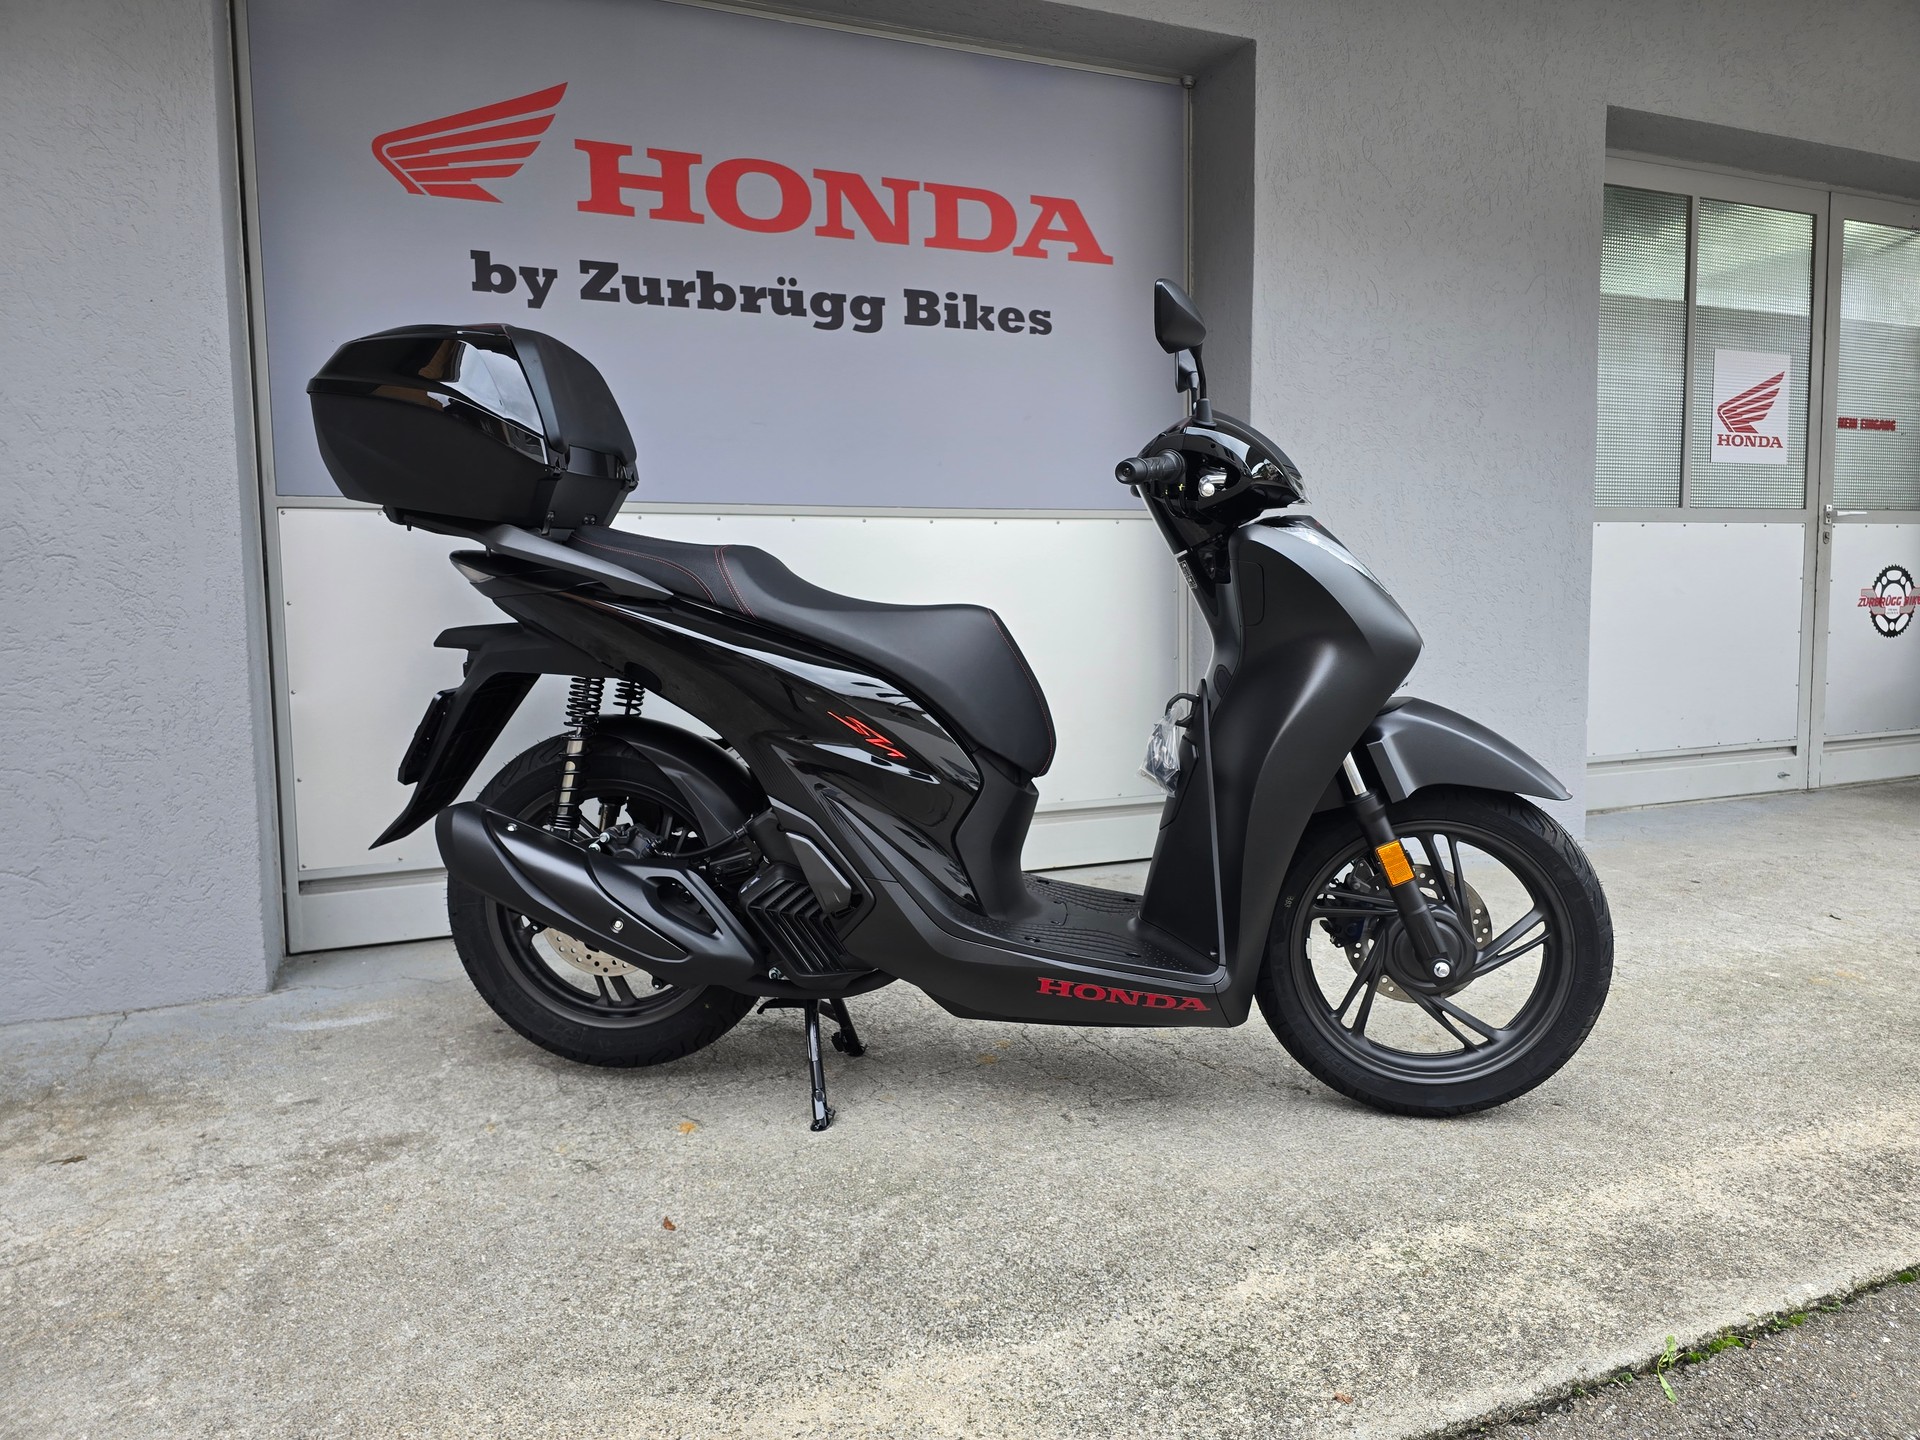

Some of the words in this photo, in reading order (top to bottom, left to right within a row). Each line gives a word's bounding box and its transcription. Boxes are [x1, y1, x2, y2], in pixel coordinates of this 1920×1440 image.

[574, 138, 1114, 265] HONDA
[469, 249, 558, 309] by
[579, 259, 886, 334] Zurbrügg
[903, 288, 1053, 336] Bikes
[1716, 434, 1783, 449] HONDA
[1036, 976, 1212, 1012] HONDA
